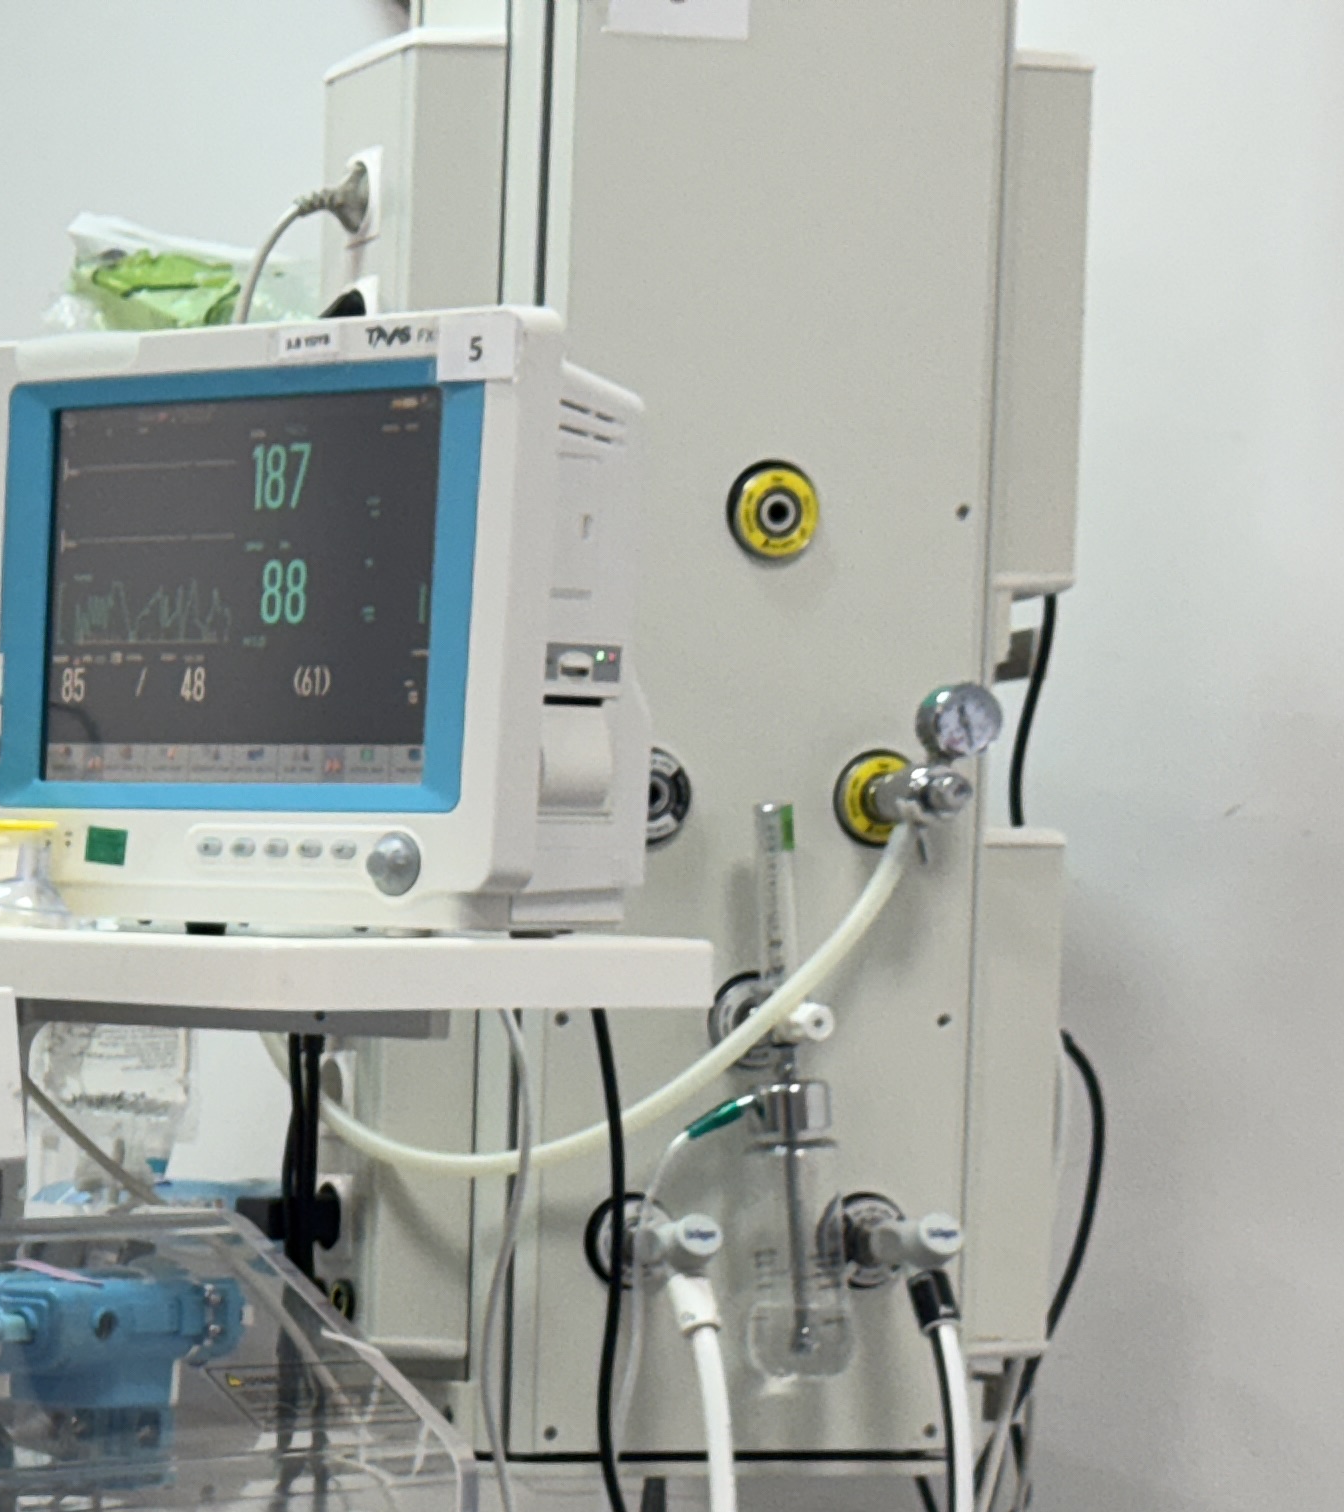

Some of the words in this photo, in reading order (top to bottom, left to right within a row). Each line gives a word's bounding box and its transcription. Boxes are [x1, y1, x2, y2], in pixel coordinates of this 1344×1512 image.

[467, 335, 484, 363] 5
[252, 442, 312, 511] 187
[260, 558, 308, 625] 88
[60, 666, 86, 703] 85
[179, 665, 206, 703] 48
[292, 664, 332, 699] (61)
